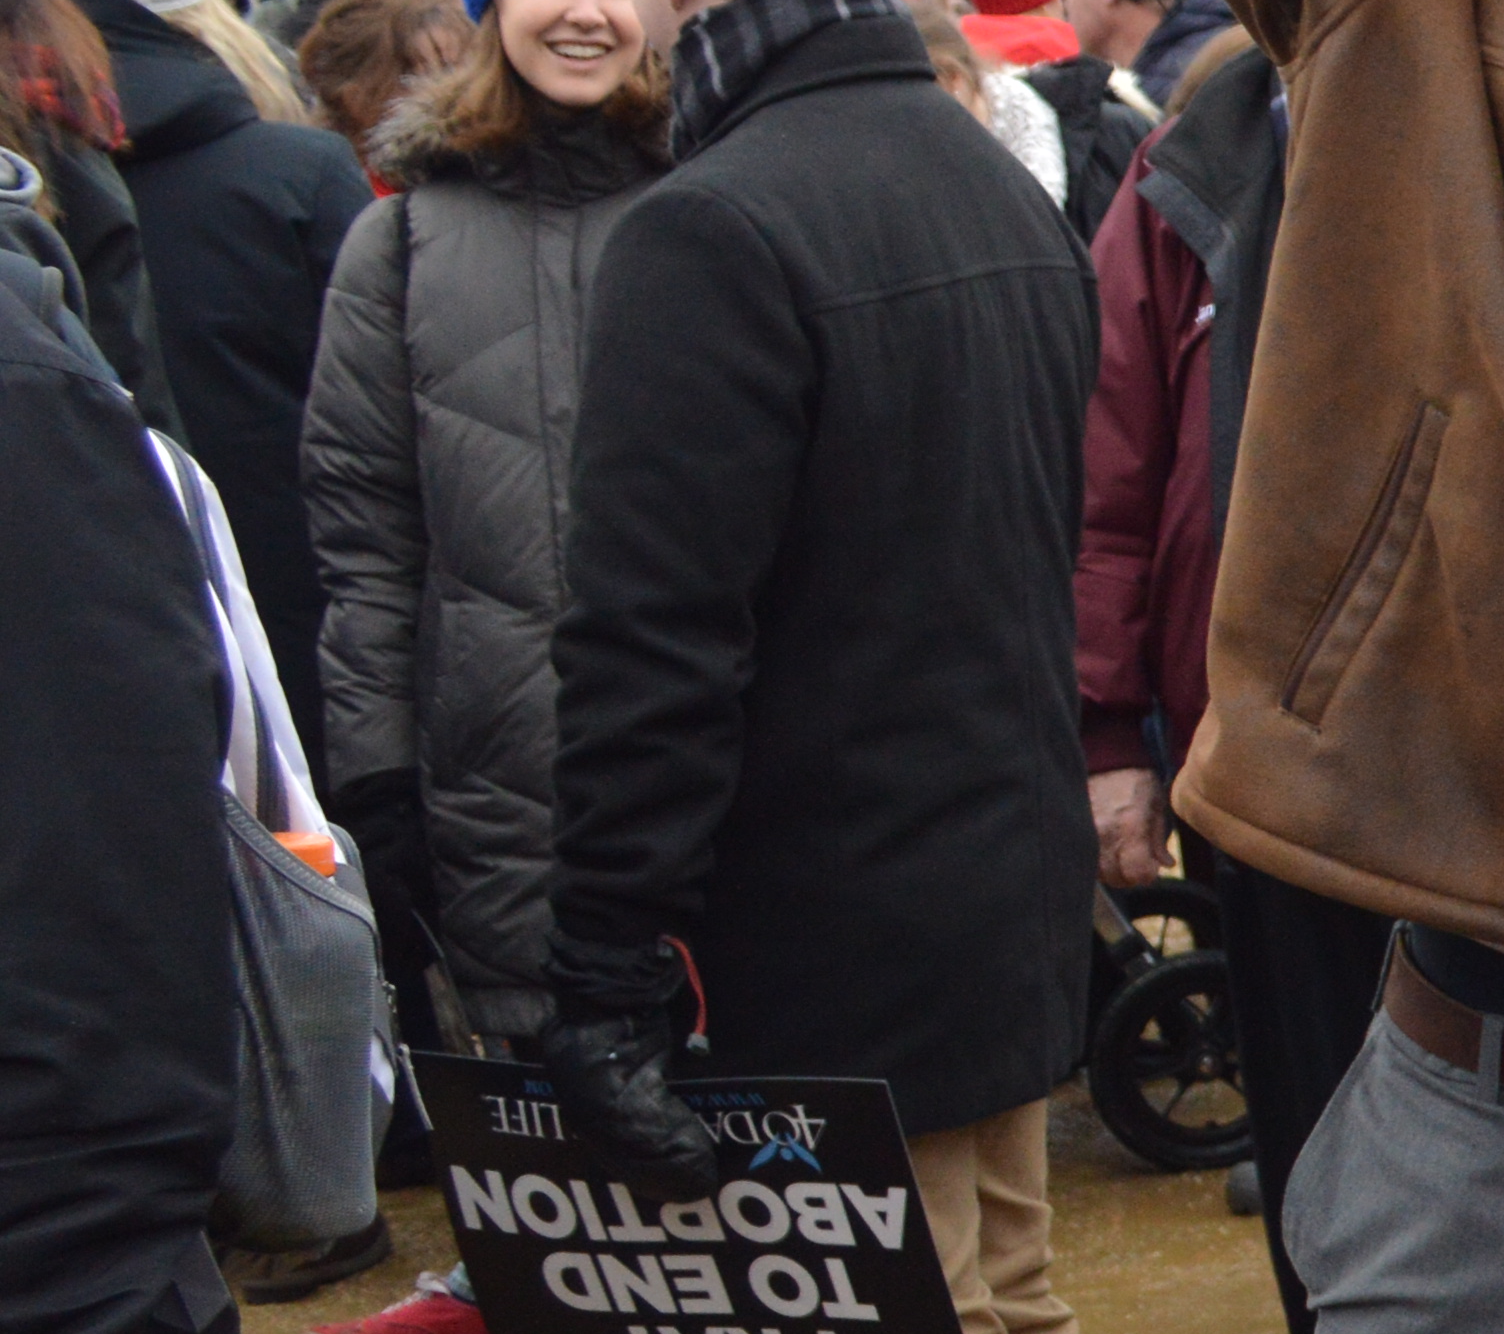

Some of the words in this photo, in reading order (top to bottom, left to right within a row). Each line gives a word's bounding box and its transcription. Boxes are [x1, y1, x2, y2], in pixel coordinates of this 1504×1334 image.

[481, 1094, 565, 1142] LIFE
[450, 1165, 907, 1250] ABORTION
[542, 1251, 735, 1315] END
[748, 1254, 881, 1322] TO
